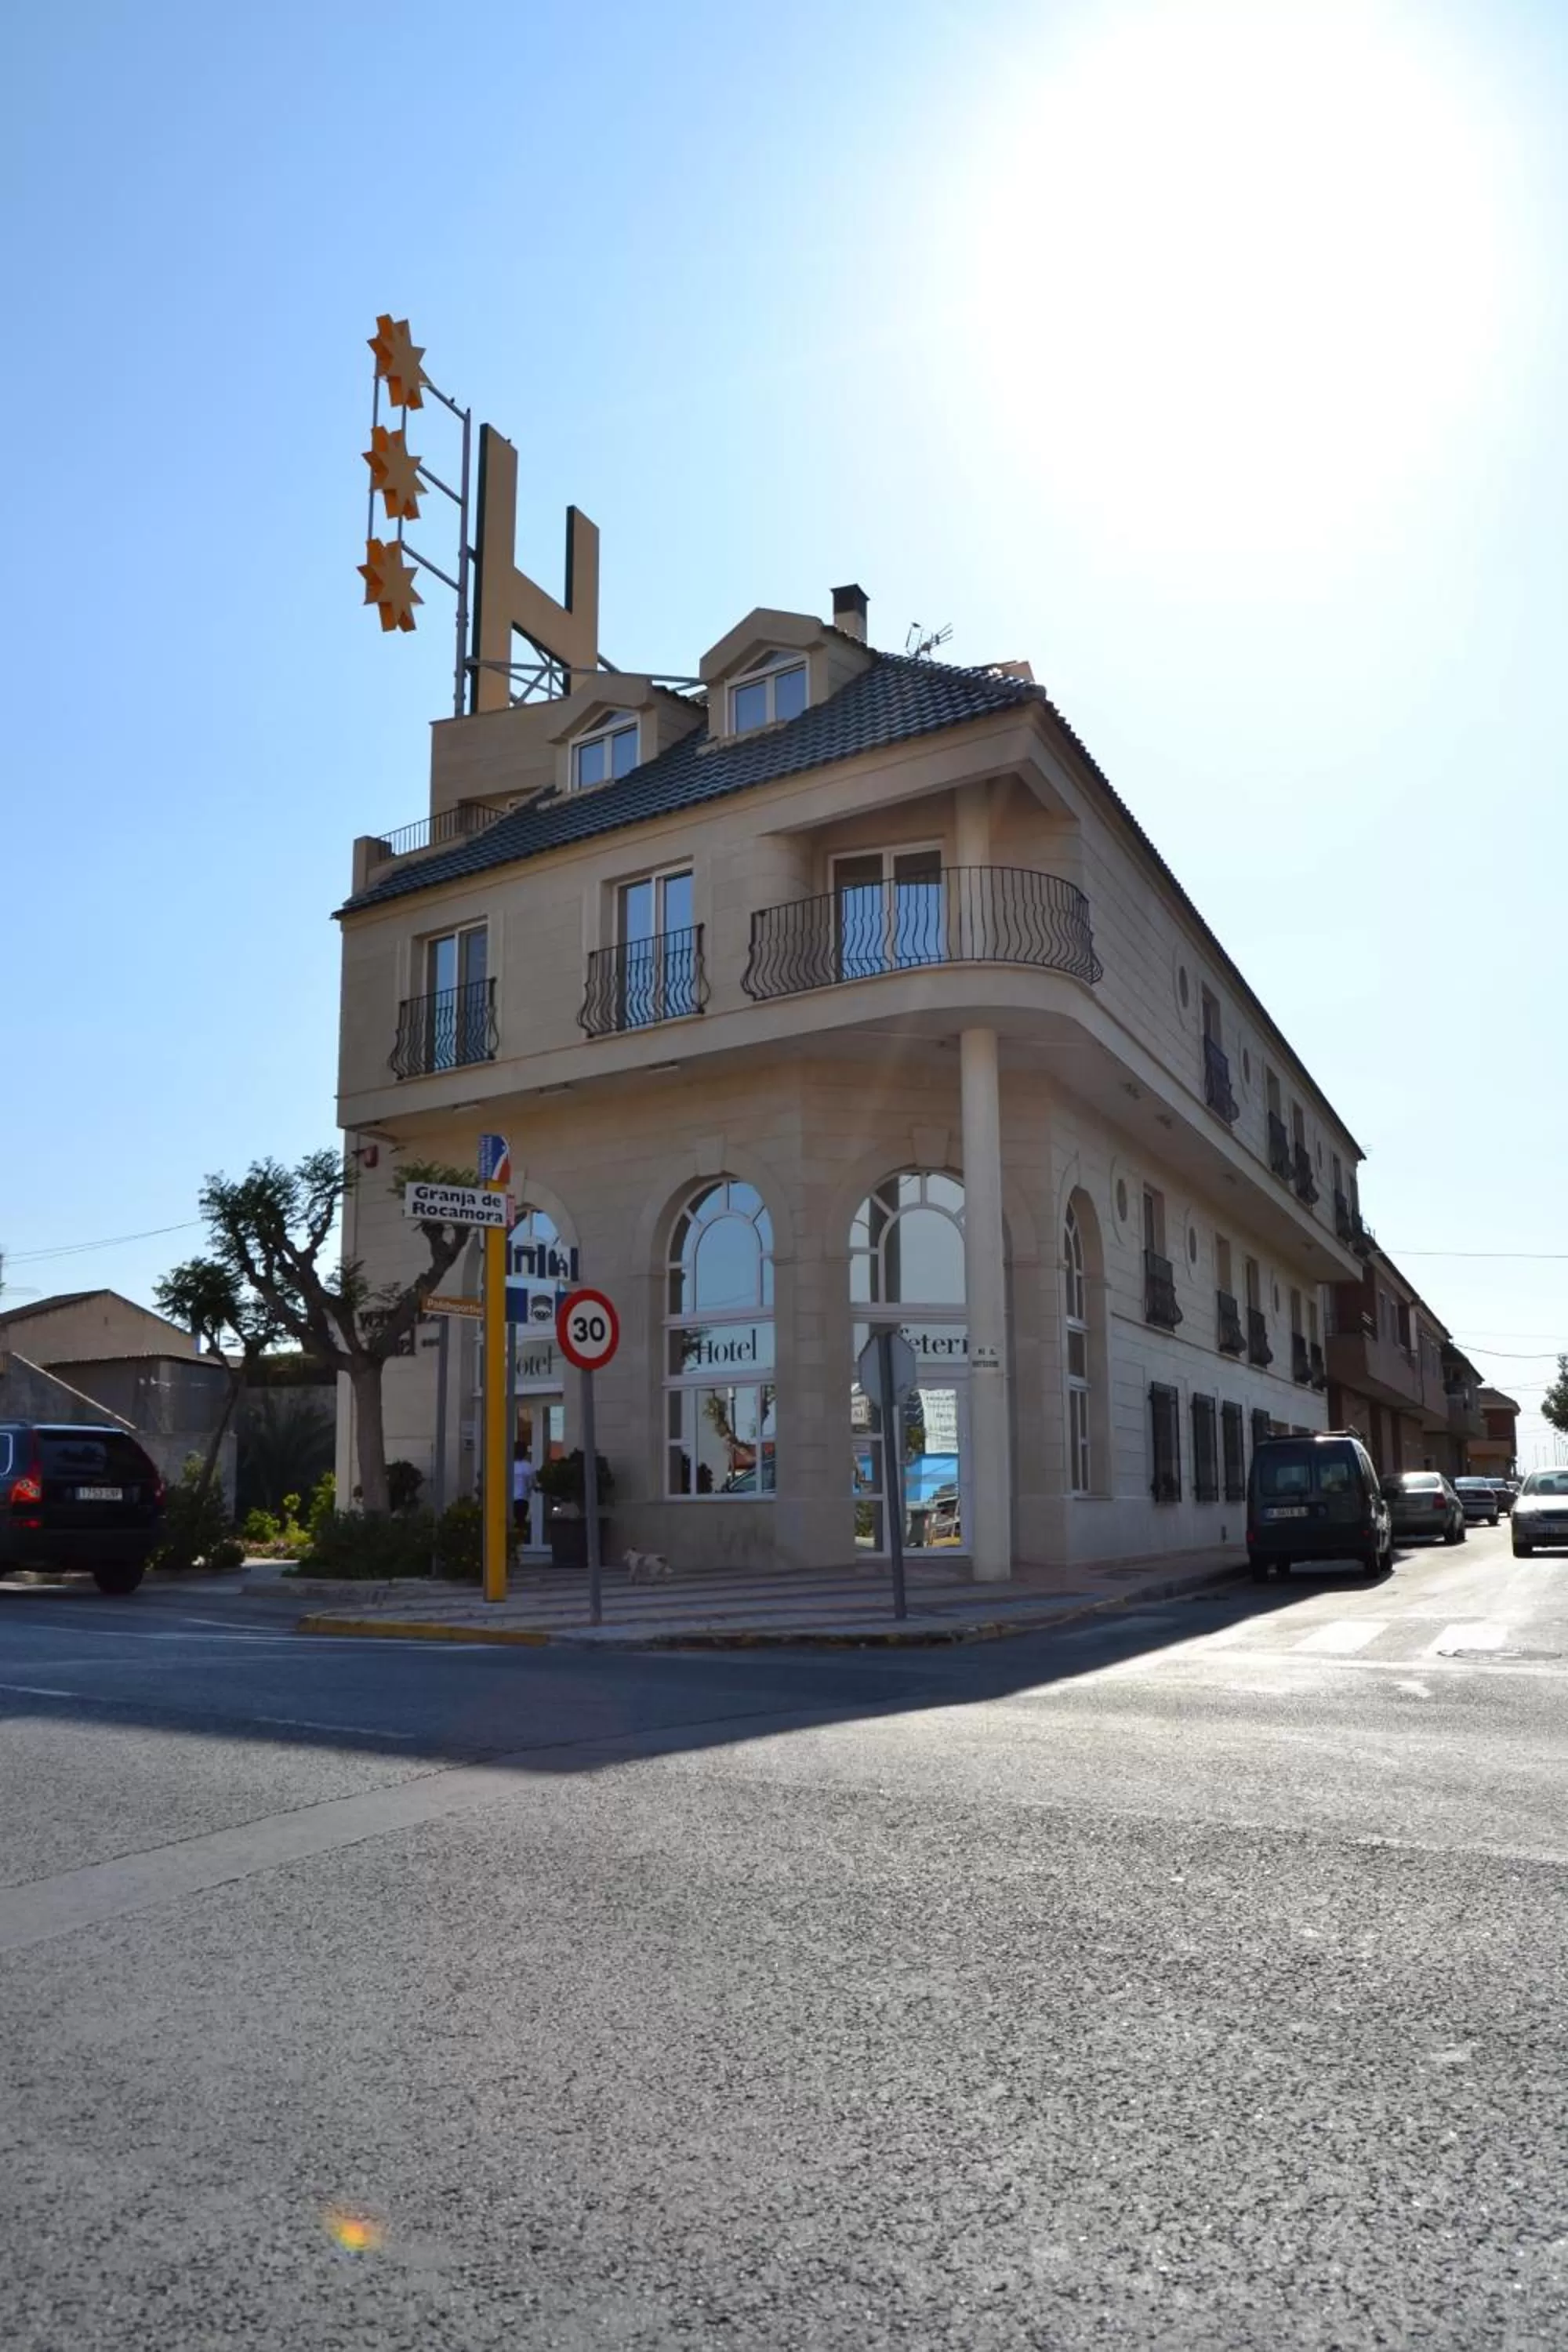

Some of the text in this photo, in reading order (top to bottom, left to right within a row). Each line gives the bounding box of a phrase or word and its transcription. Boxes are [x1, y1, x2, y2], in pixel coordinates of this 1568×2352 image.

[415, 1186, 502, 1208] Granja de
[412, 1201, 503, 1223] Rocamora
[573, 1316, 606, 1343] 30
[696, 1328, 757, 1364] Hotel
[516, 1345, 552, 1377] otel
